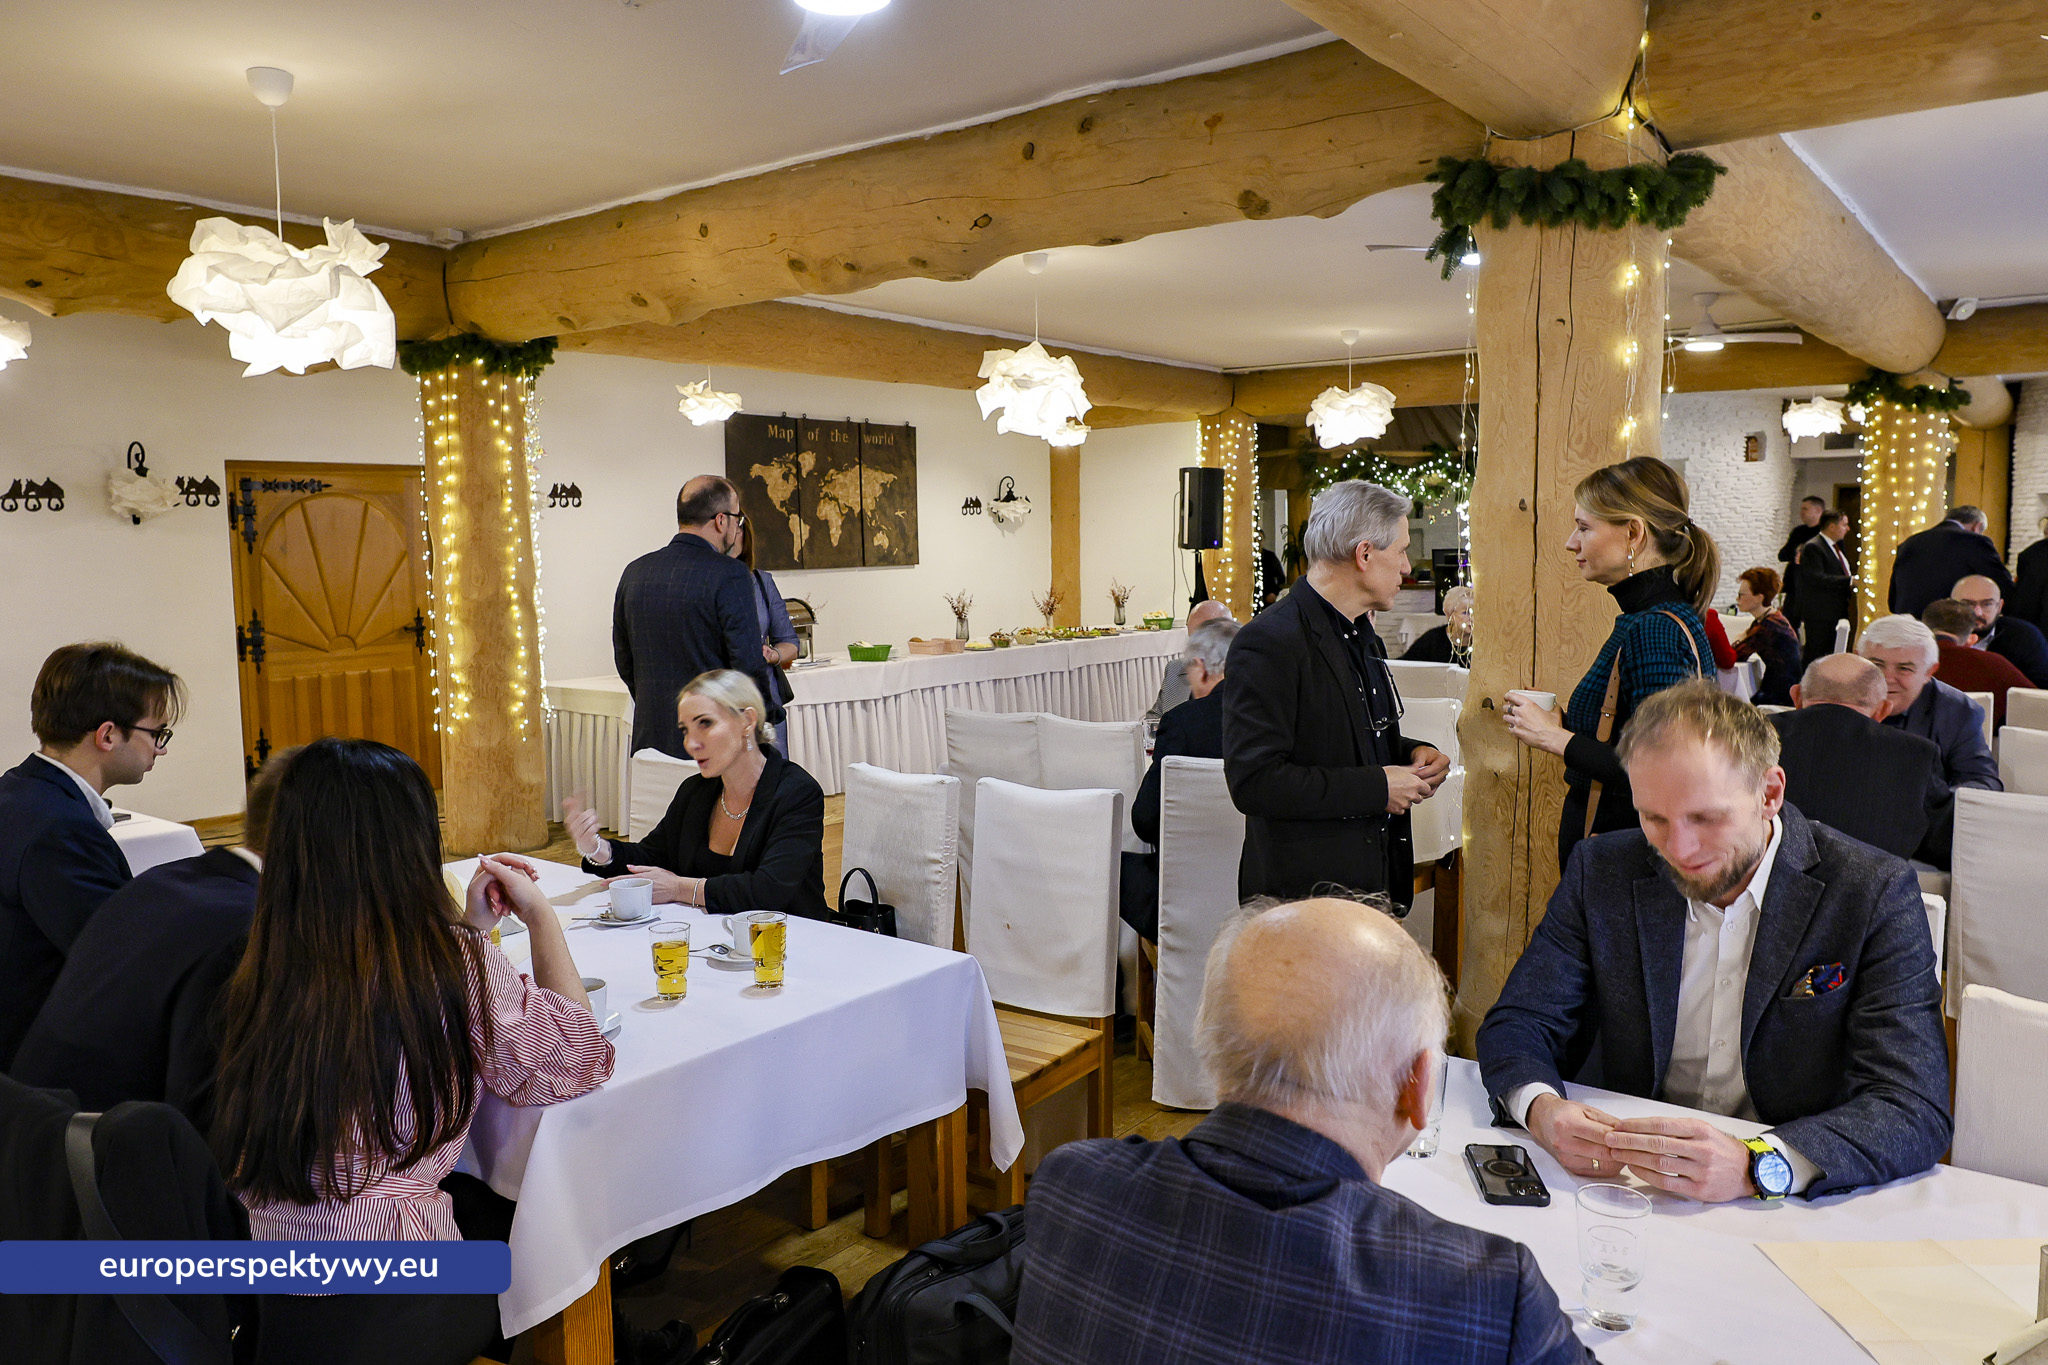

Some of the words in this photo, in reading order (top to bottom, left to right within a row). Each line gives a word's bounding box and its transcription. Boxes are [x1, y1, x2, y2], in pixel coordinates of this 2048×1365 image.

[767, 424, 794, 443] Map
[807, 427, 820, 442] of
[830, 429, 849, 443] the
[863, 431, 894, 446] world
